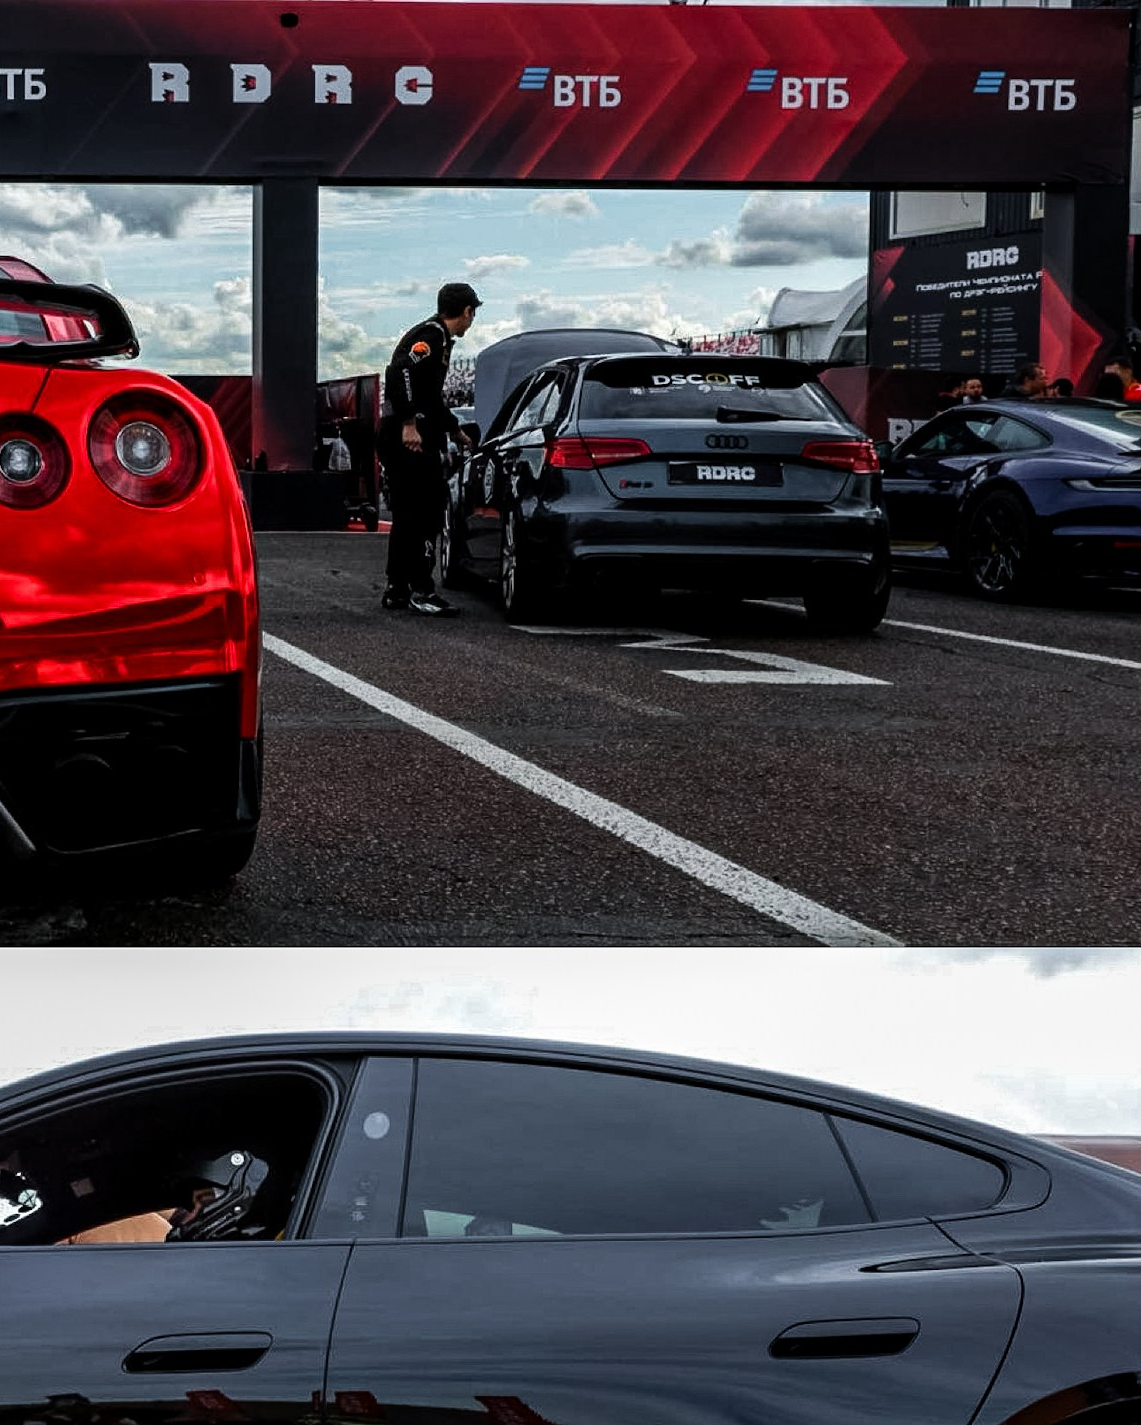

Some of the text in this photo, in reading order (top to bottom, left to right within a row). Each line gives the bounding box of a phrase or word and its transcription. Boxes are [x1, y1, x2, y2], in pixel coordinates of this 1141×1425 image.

[553, 75, 621, 107] ВТБ
[780, 77, 850, 110] ВТБ
[1007, 79, 1077, 111] ВТБ
[966, 245, 1020, 270] RDRC
[696, 465, 756, 481] RDRC
